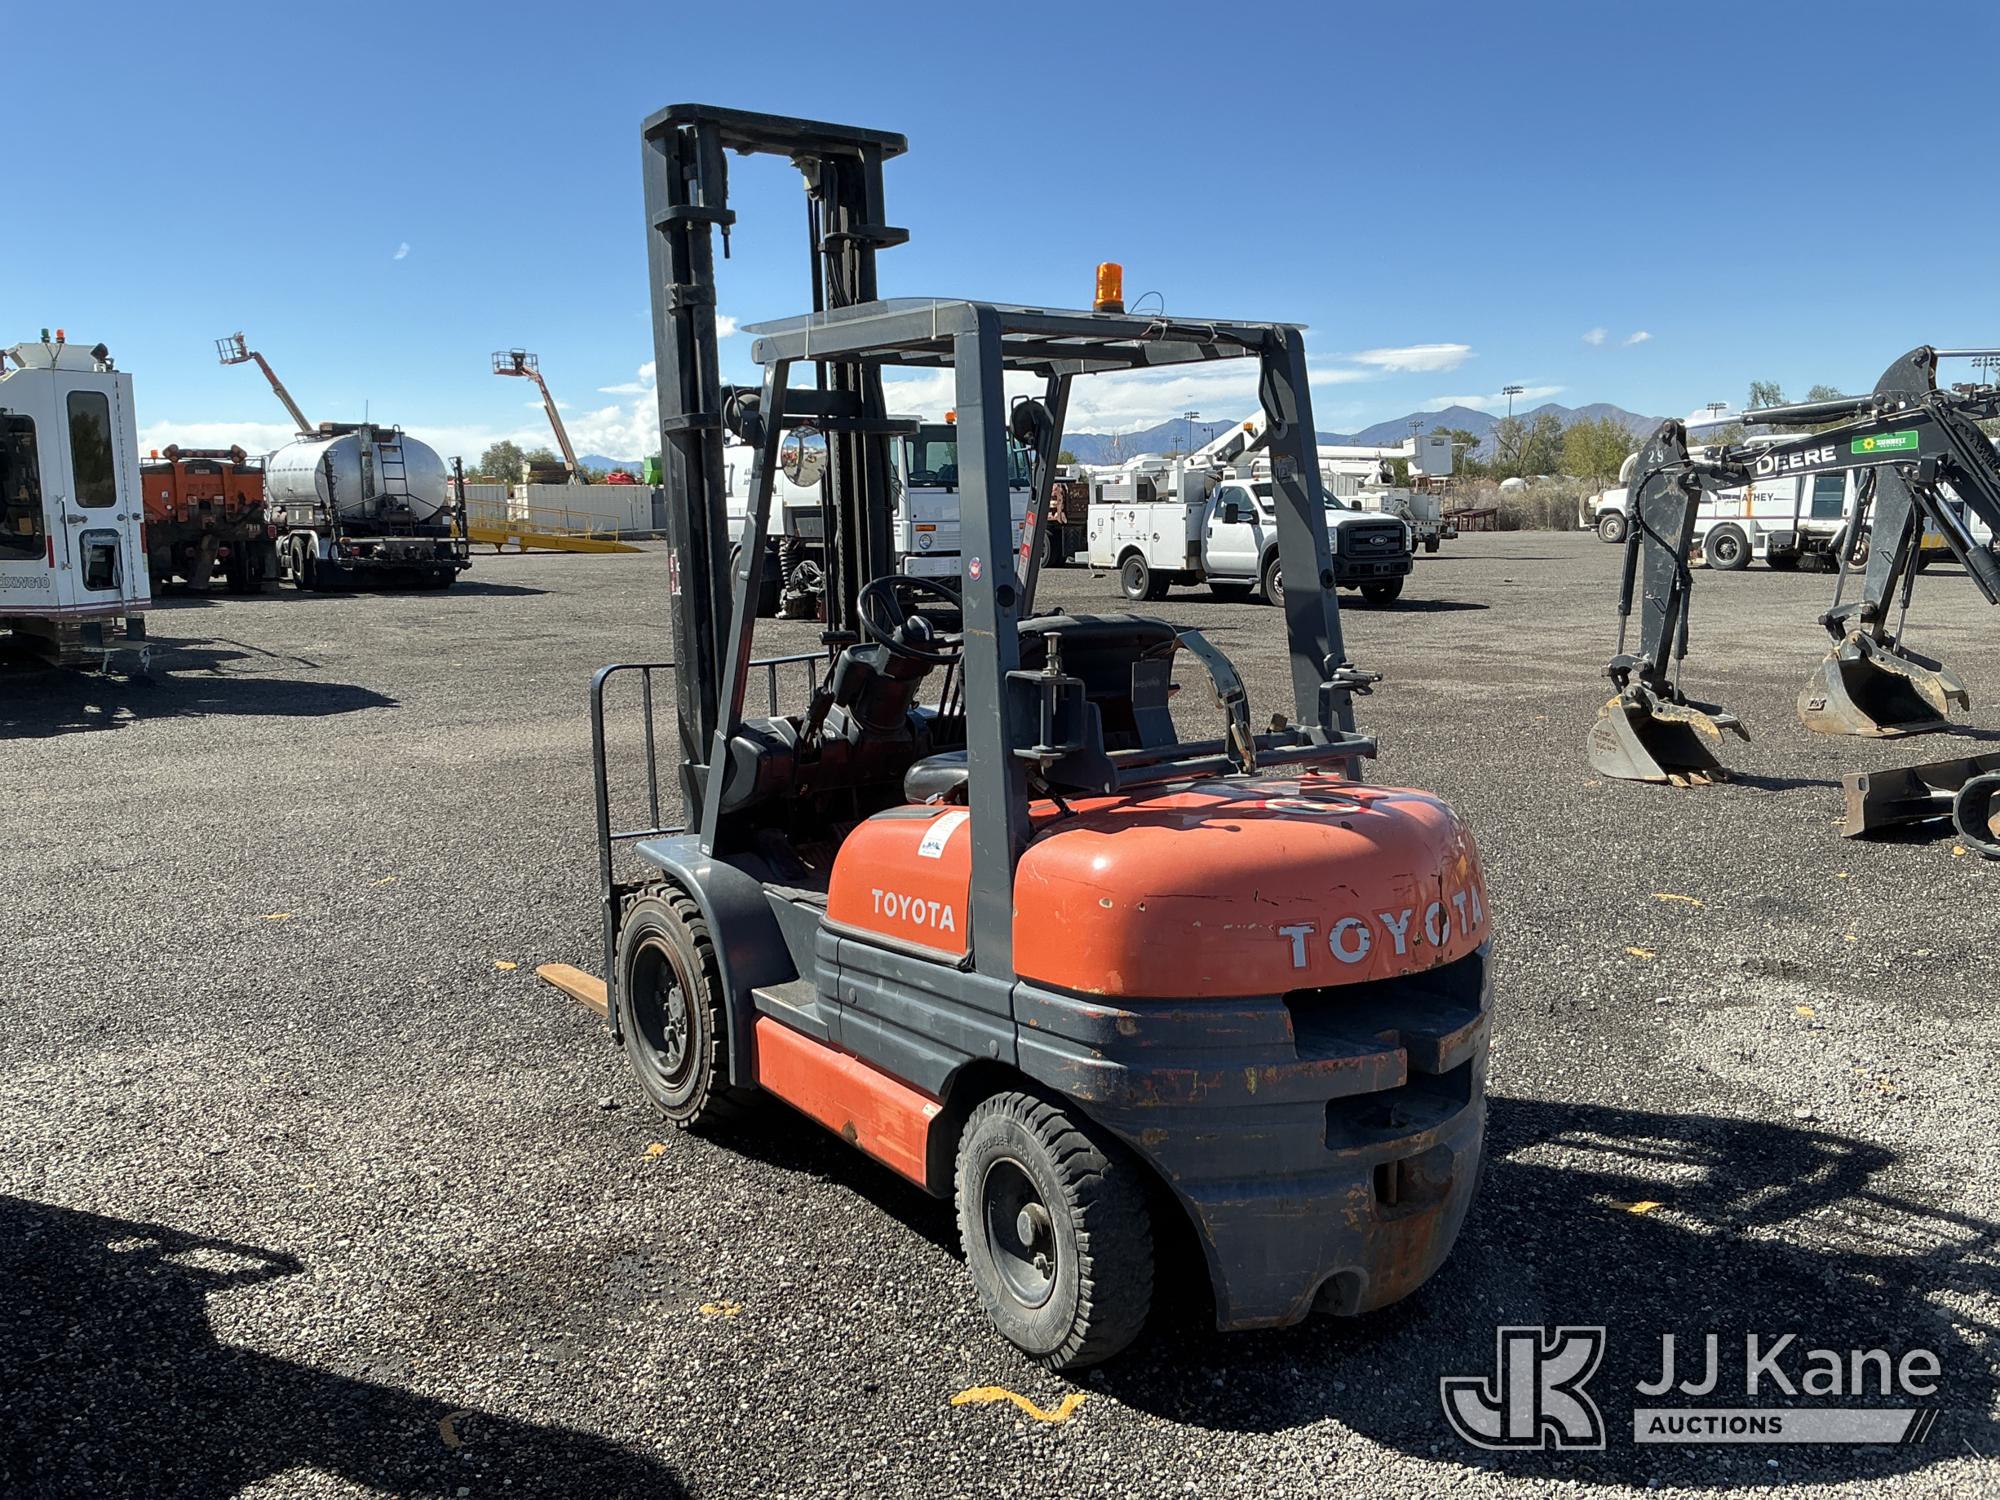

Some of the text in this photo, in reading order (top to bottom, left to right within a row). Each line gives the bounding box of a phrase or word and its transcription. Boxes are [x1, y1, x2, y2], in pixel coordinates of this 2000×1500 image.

[1648, 449, 1664, 463] 29
[1755, 445, 1837, 475] DEERE
[871, 888, 956, 933] TOYOTA
[1279, 884, 1485, 968] TOYOTA
